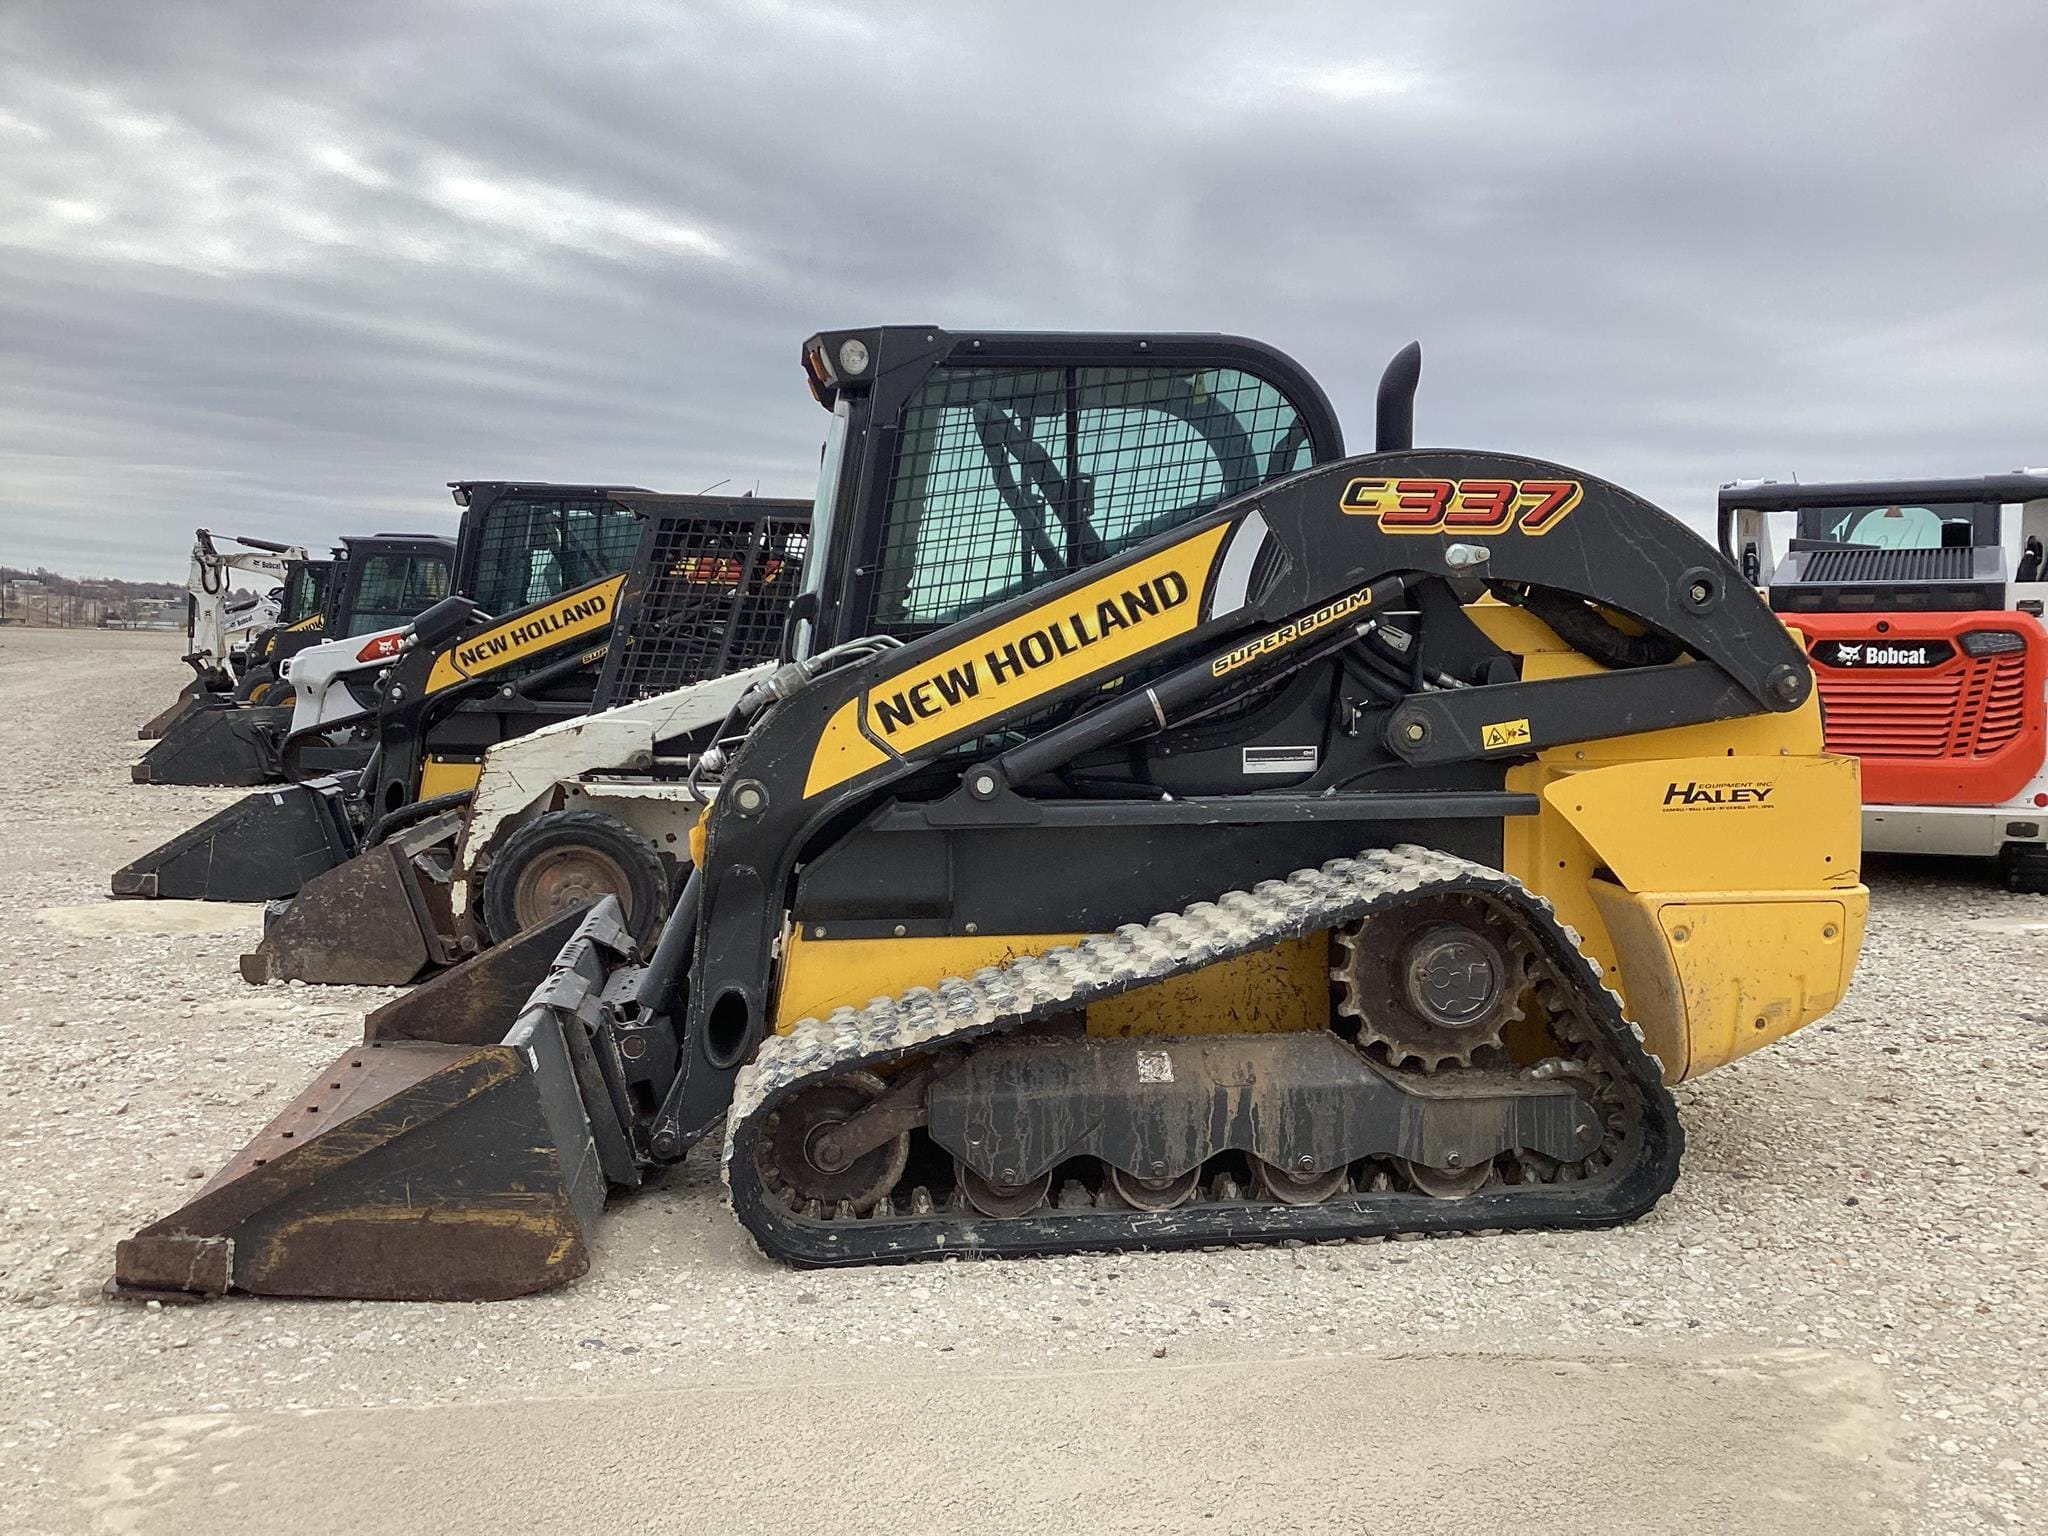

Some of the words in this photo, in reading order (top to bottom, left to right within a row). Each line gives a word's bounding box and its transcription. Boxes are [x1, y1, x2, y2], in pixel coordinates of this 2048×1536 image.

[262, 561, 281, 570] Bobcat
[459, 635, 509, 667] NEW
[510, 595, 606, 646] HOLLAND
[1212, 625, 1296, 677] SUPER
[1298, 587, 1372, 636] BOOM
[873, 660, 981, 736] NEW
[984, 570, 1190, 687] HOLLAND
[1866, 647, 1926, 665] Bobcat
[1663, 783, 1773, 805] HALEY
[1698, 782, 1752, 790] EQUIPMENT
